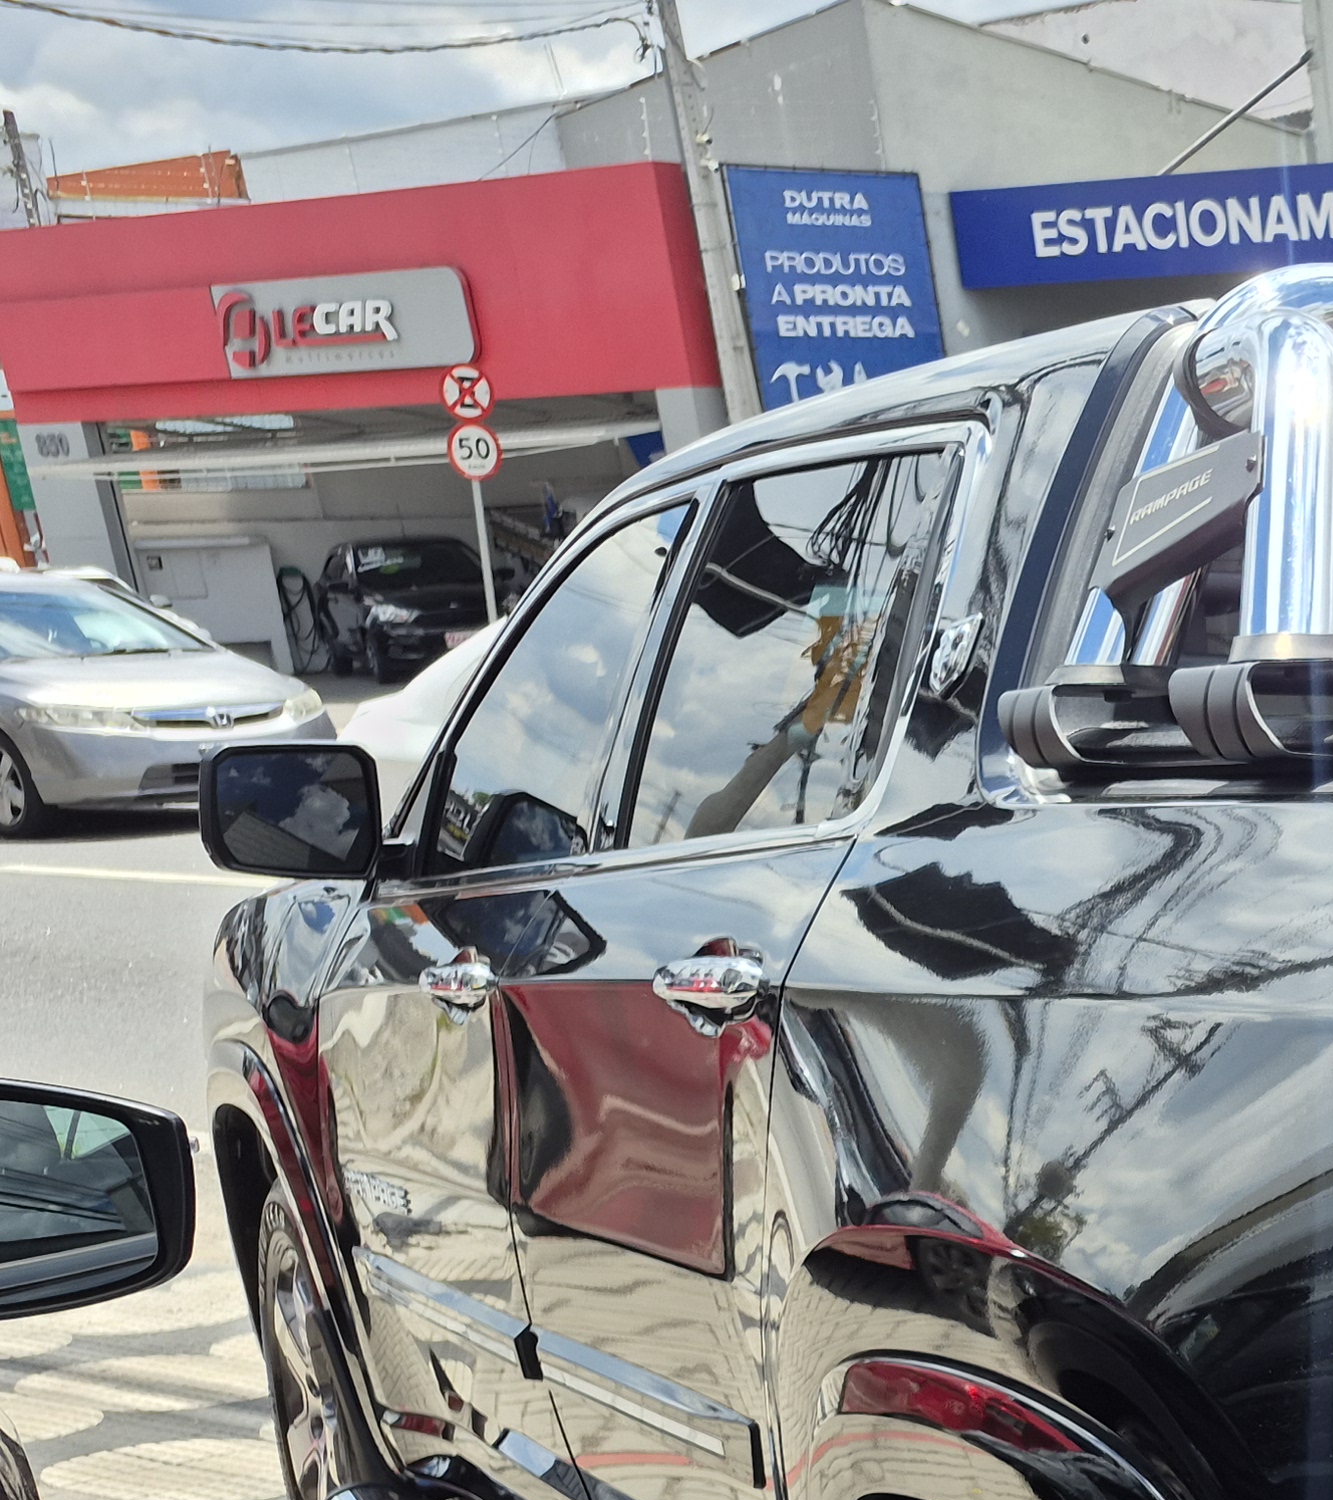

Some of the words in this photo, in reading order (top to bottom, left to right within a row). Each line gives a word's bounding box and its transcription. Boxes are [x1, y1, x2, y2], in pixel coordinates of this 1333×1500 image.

[783, 189, 869, 210] DUTRA
[765, 250, 905, 276] PRODUTOS
[771, 282, 791, 305] A
[793, 283, 912, 307] PRONTA
[777, 315, 915, 338] ENTREGA
[458, 437, 490, 461] 50
[1129, 467, 1213, 525] RAMPAGE
